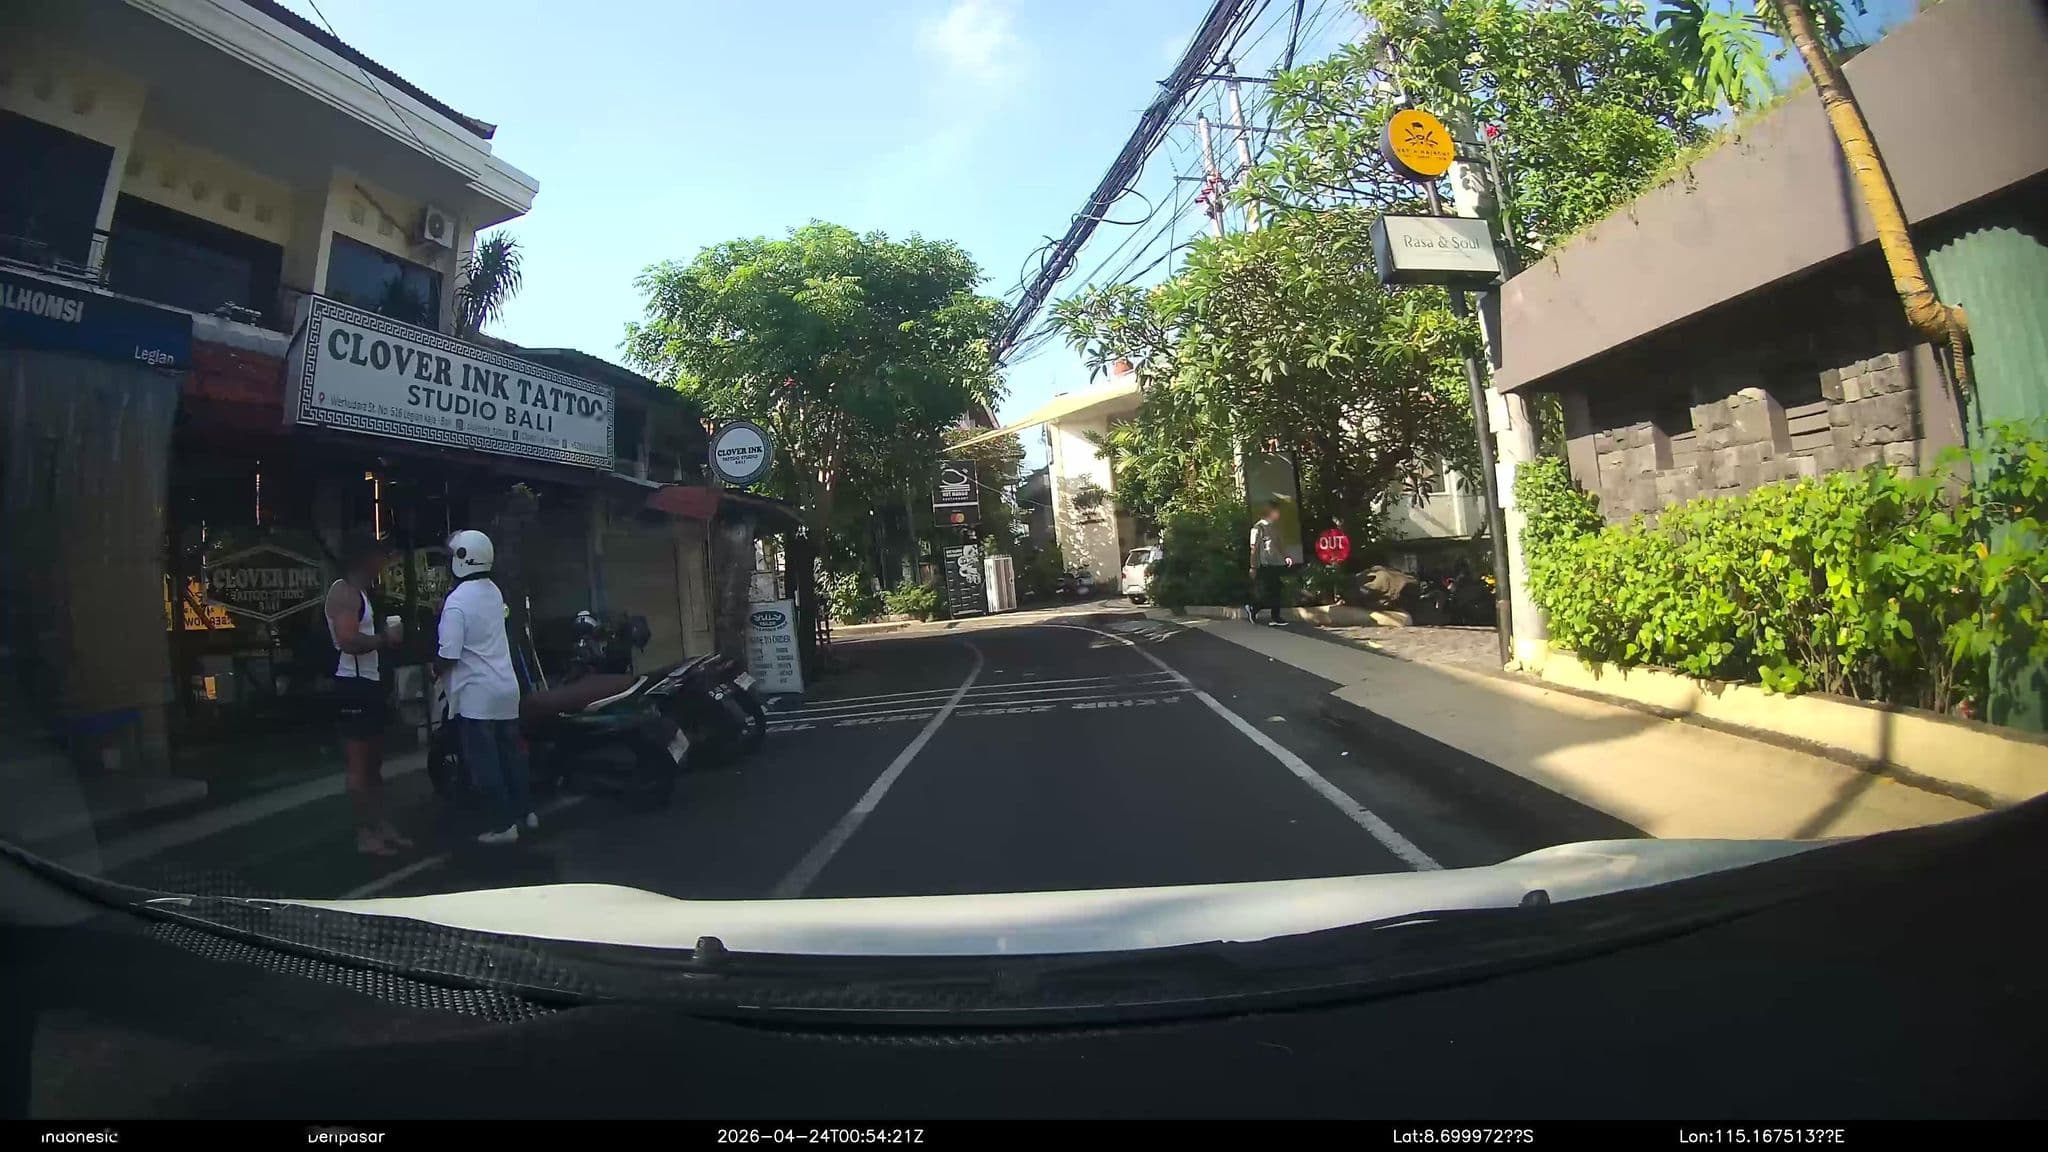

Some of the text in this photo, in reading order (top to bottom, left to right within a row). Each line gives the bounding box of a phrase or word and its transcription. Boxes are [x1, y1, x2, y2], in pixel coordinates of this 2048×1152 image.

[1403, 234, 1481, 250] Rasa & Soul
[134, 345, 175, 367] Legian
[327, 327, 453, 387] CLOVER
[460, 363, 510, 401] INK
[407, 384, 497, 421] STUDIO
[505, 405, 553, 433] BALI
[717, 445, 763, 457] CLOVER INK
[1319, 535, 1345, 550] OUT
[212, 567, 321, 590] CLOVER INK
